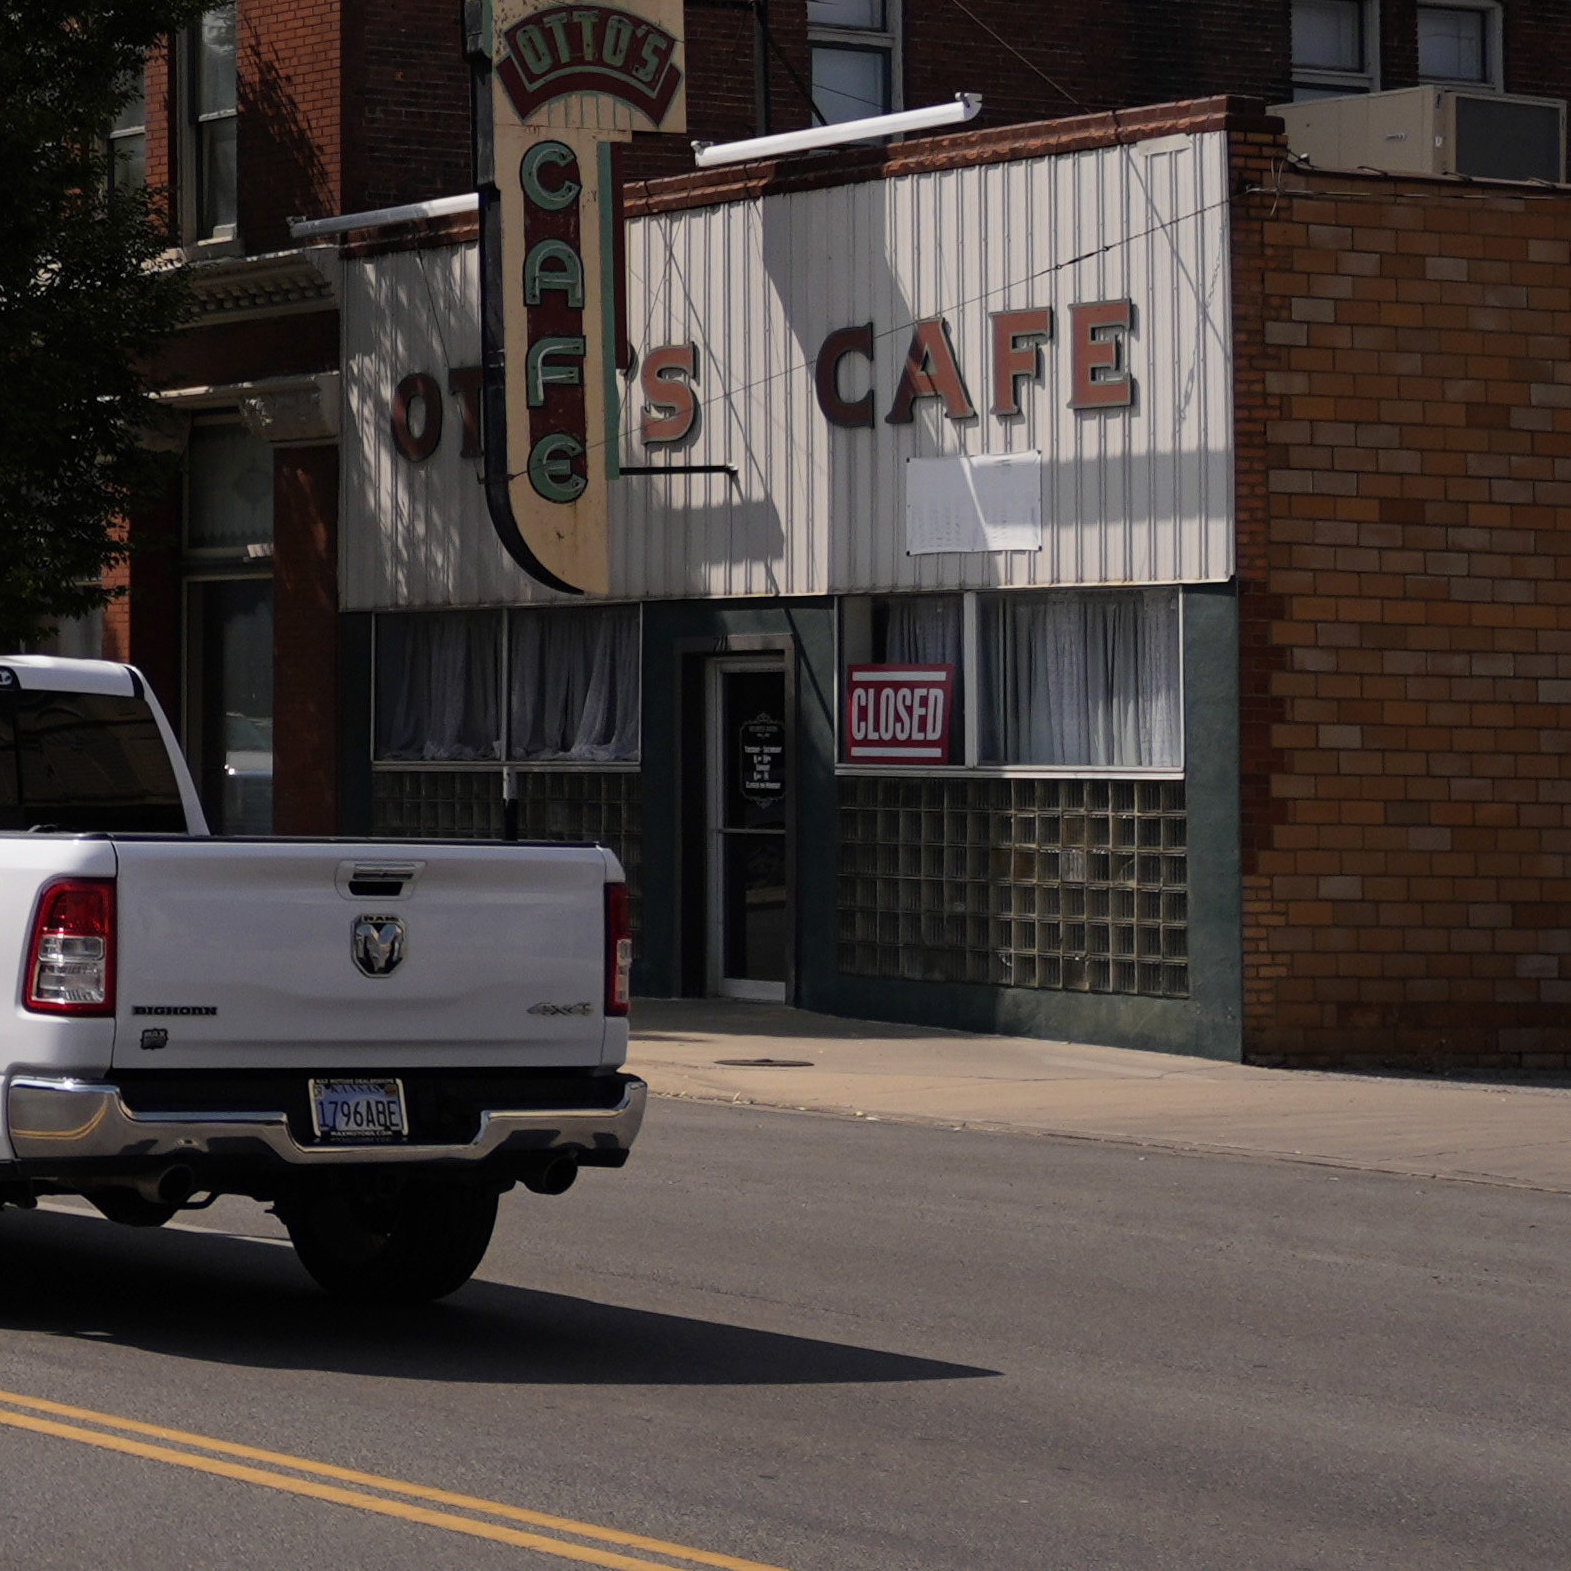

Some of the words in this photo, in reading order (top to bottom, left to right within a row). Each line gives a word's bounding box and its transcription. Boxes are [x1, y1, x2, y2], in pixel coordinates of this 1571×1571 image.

[515, 10, 669, 83] OTTO'S
[519, 141, 589, 504] CAFE
[816, 297, 1137, 429] CAFE
[850, 686, 945, 742] CLOSED
[132, 1005, 218, 1016] BIGHORN
[317, 1099, 400, 1128] 1796ABE
